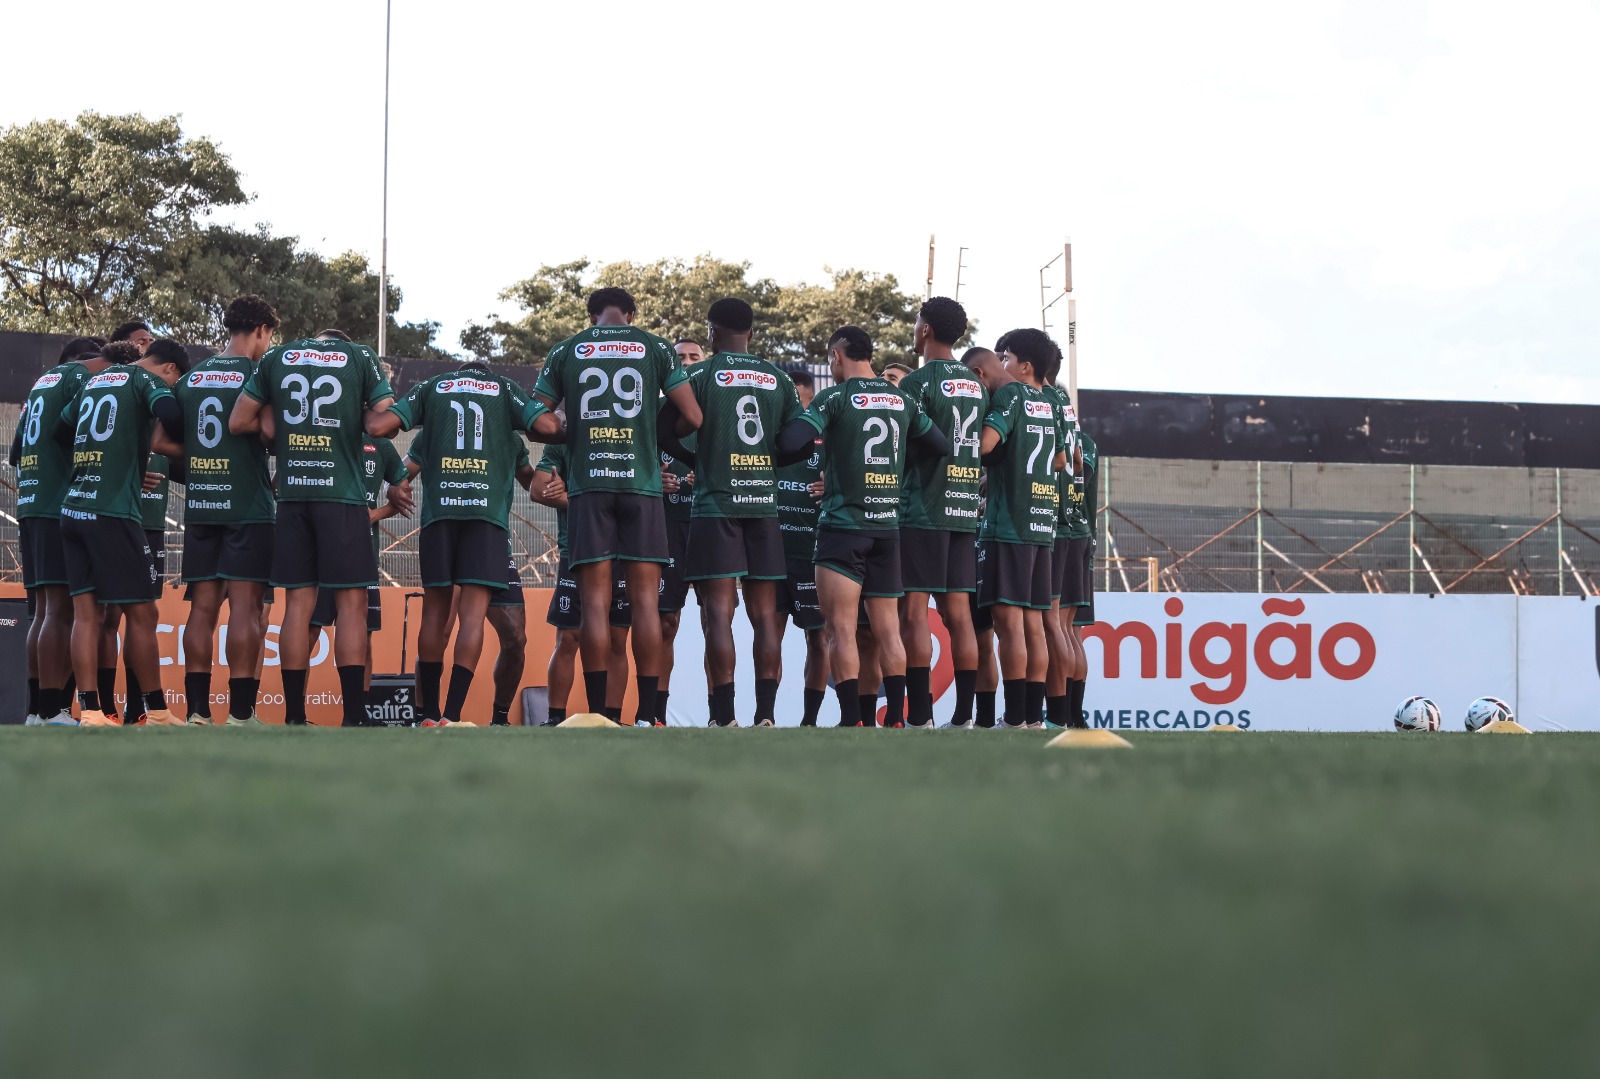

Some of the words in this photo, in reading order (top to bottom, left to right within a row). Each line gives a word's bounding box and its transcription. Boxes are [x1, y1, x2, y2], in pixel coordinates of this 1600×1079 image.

[599, 342, 644, 354] amigão
[304, 352, 346, 365] amigão
[205, 373, 243, 383] amigão
[457, 378, 499, 390] amigão
[738, 373, 775, 385] amigão
[578, 367, 643, 420] 29
[280, 373, 342, 428] 32
[871, 395, 902, 406] amigão
[74, 394, 118, 447] 20
[197, 396, 223, 448] 6
[450, 400, 484, 450] 11
[736, 395, 764, 445] 8
[590, 427, 633, 440] REVEST
[289, 434, 331, 446] REVEST
[190, 457, 230, 470] REVEST
[441, 457, 488, 470] REVEST
[731, 454, 772, 466] REVEST
[589, 467, 635, 478] Unimed
[946, 464, 980, 479] REVEST
[287, 476, 334, 487] Unimed
[188, 499, 231, 510] Unimed
[440, 497, 488, 507] Unimed
[732, 493, 774, 504] Unimed
[944, 507, 978, 518] Unimed
[1081, 597, 1376, 704] migão
